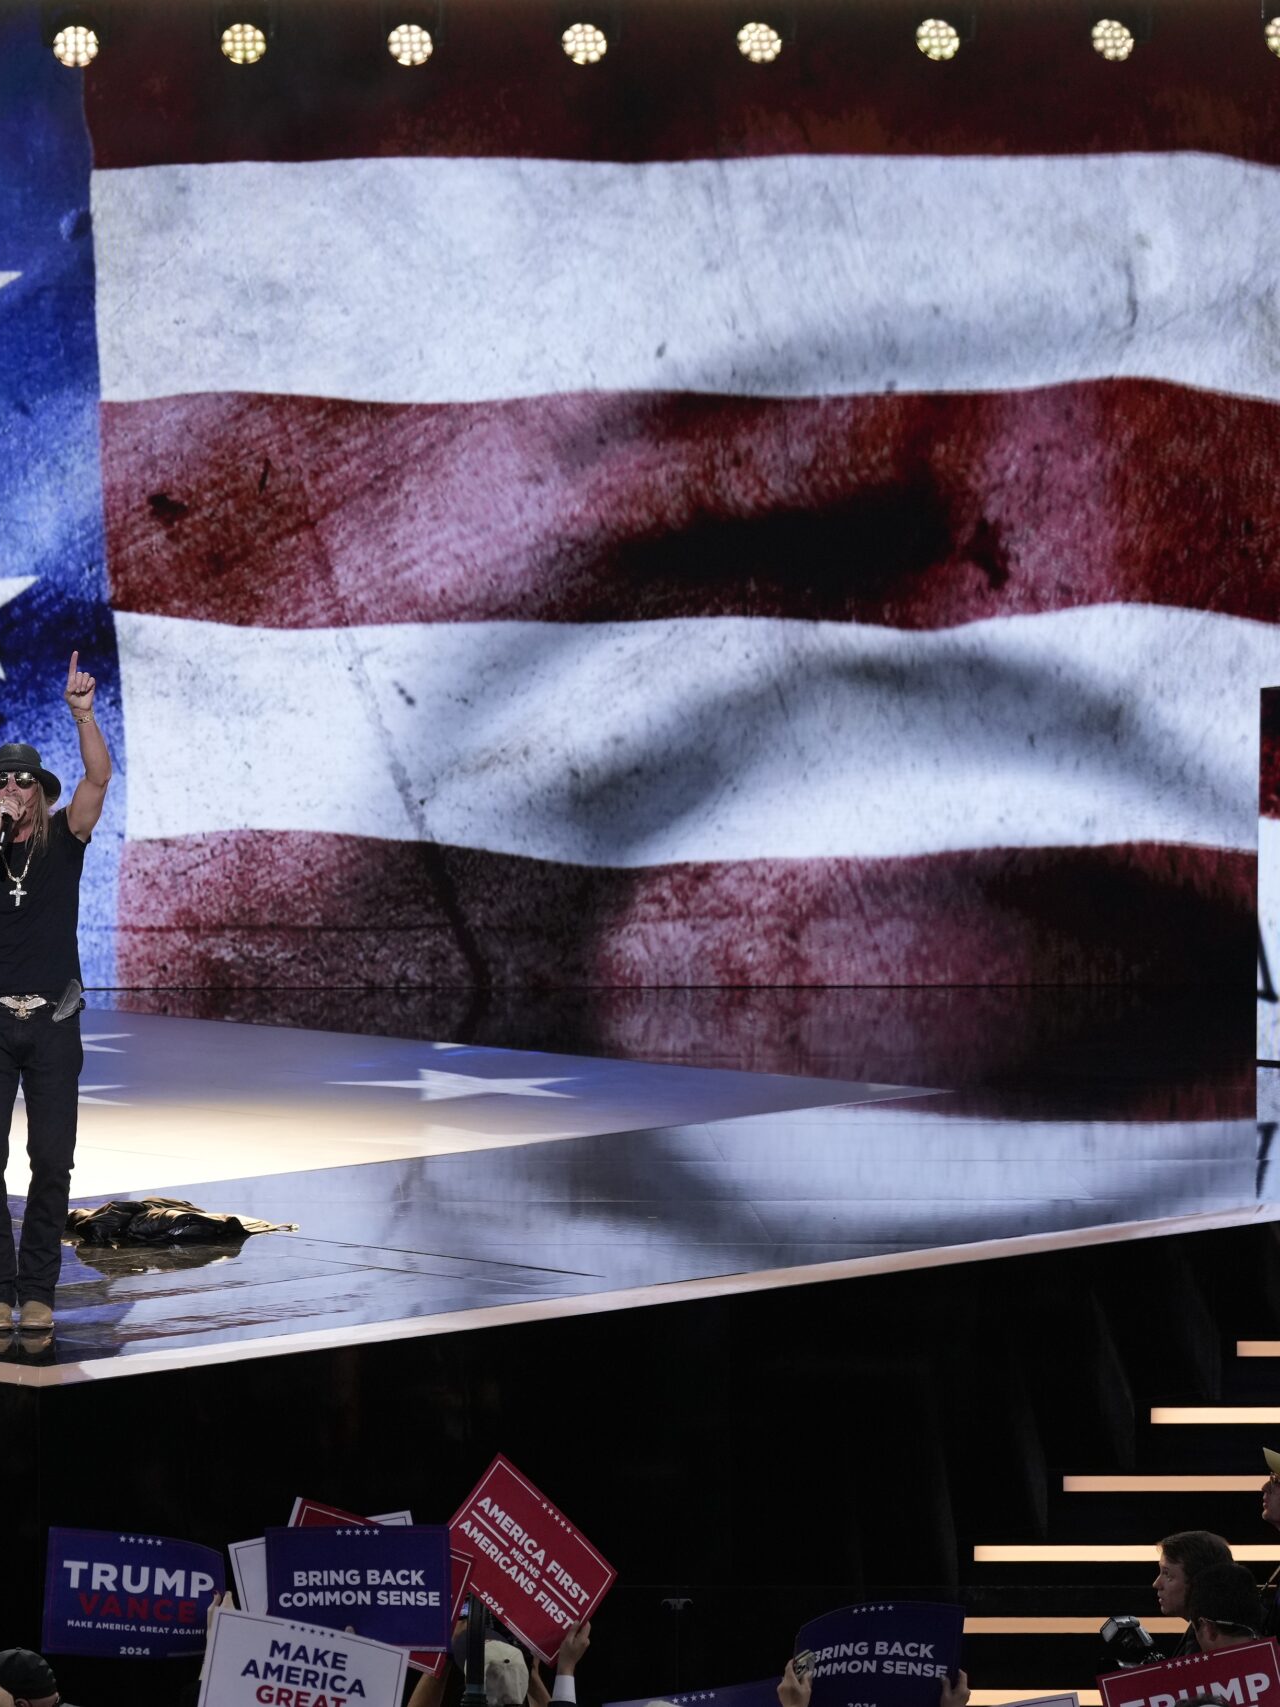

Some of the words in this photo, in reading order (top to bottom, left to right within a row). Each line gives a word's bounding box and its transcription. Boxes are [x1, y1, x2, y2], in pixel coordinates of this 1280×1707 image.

[477, 1496, 546, 1566] AMERICA
[545, 1560, 590, 1606] FIRST
[509, 1547, 541, 1579] MEANS
[62, 1559, 215, 1599] TRUMP
[293, 1569, 361, 1587] BRING
[366, 1569, 426, 1586] BACK
[458, 1520, 537, 1595] AMERICANS
[533, 1590, 575, 1630] FIRST
[79, 1591, 198, 1624] VANCE
[278, 1590, 372, 1608] COMMON
[376, 1590, 441, 1607] SENSE
[480, 1591, 505, 1616] 2024
[67, 1619, 93, 1629] MAKE
[95, 1621, 137, 1632] AMERICA
[139, 1625, 170, 1635] GREAT
[119, 1646, 151, 1656] 2024
[269, 1640, 348, 1672] MAKE
[874, 1641, 935, 1659] BACK
[241, 1659, 366, 1699] AMERICA
[813, 1659, 877, 1679] MMON
[256, 1684, 347, 1707] GREAT
